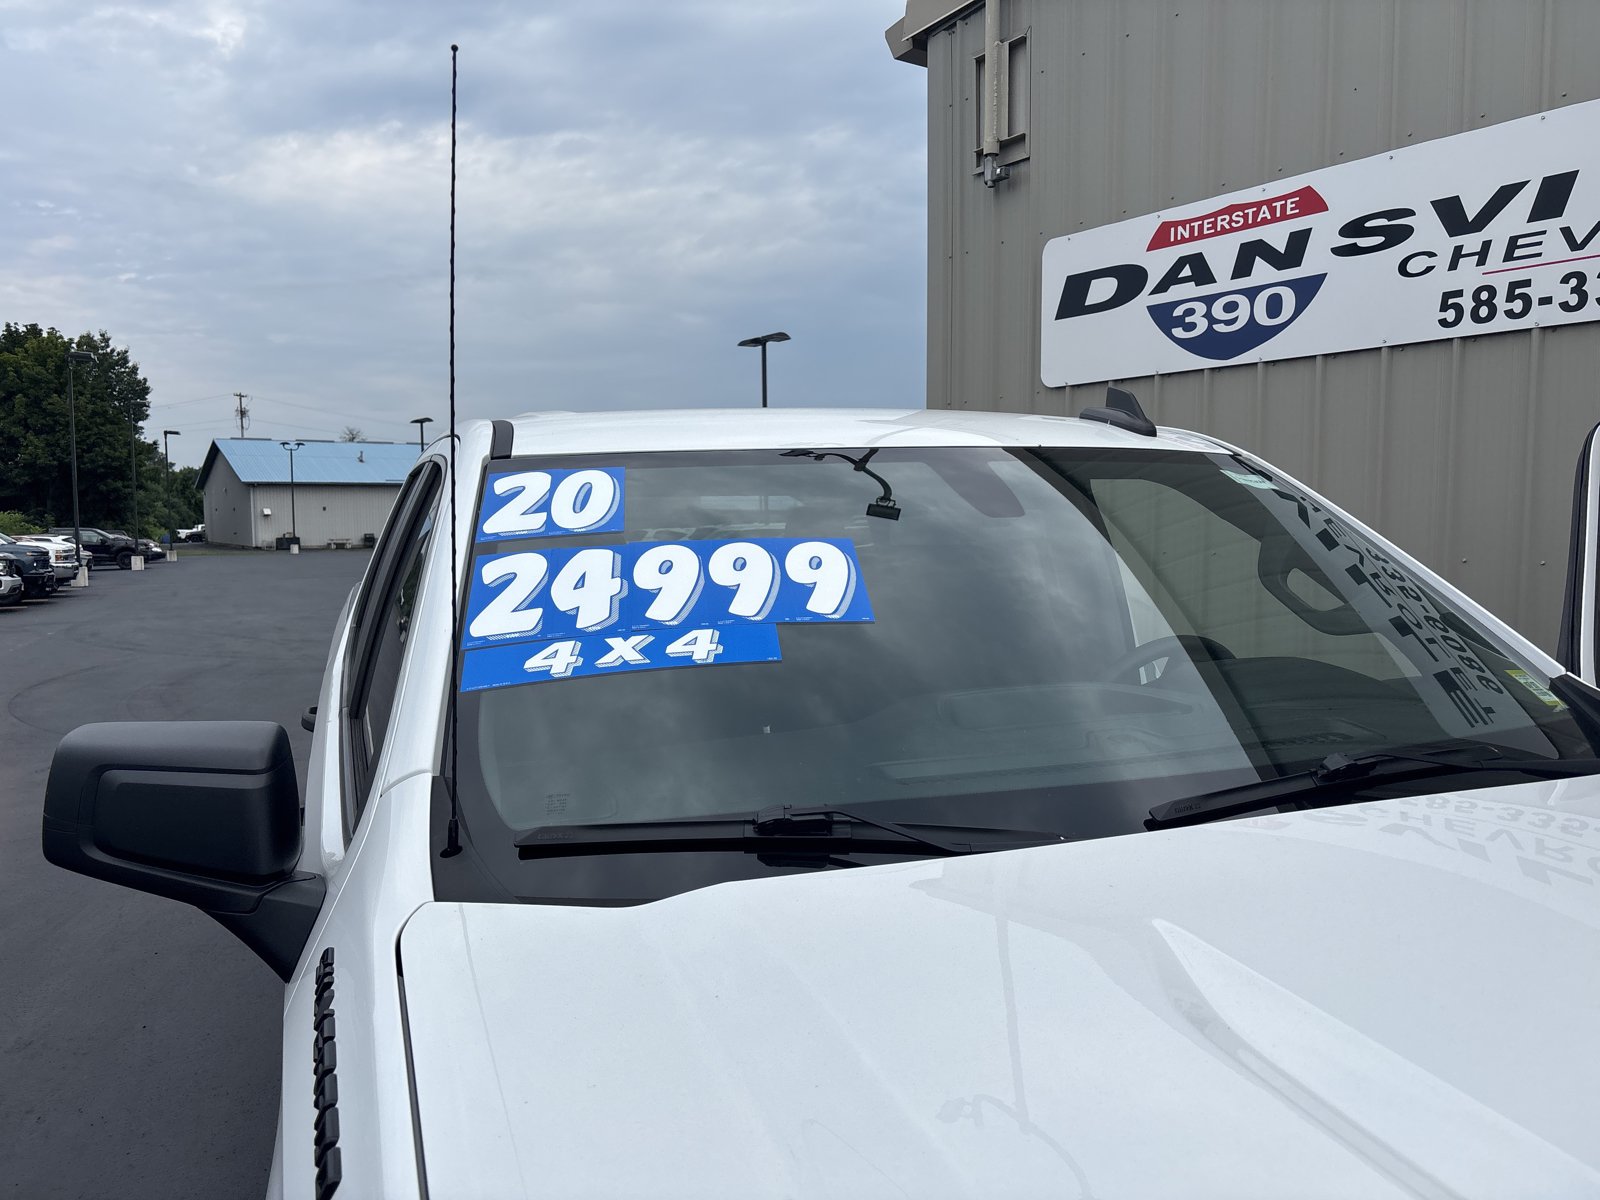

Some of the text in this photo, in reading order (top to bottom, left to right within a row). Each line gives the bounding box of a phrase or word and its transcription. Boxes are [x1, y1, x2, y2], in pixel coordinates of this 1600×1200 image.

[1168, 196, 1301, 243] INTERSTATE
[1170, 285, 1297, 339] 390
[1437, 270, 1600, 329] 585-3
[481, 469, 620, 536] 20
[469, 541, 857, 640] 24999
